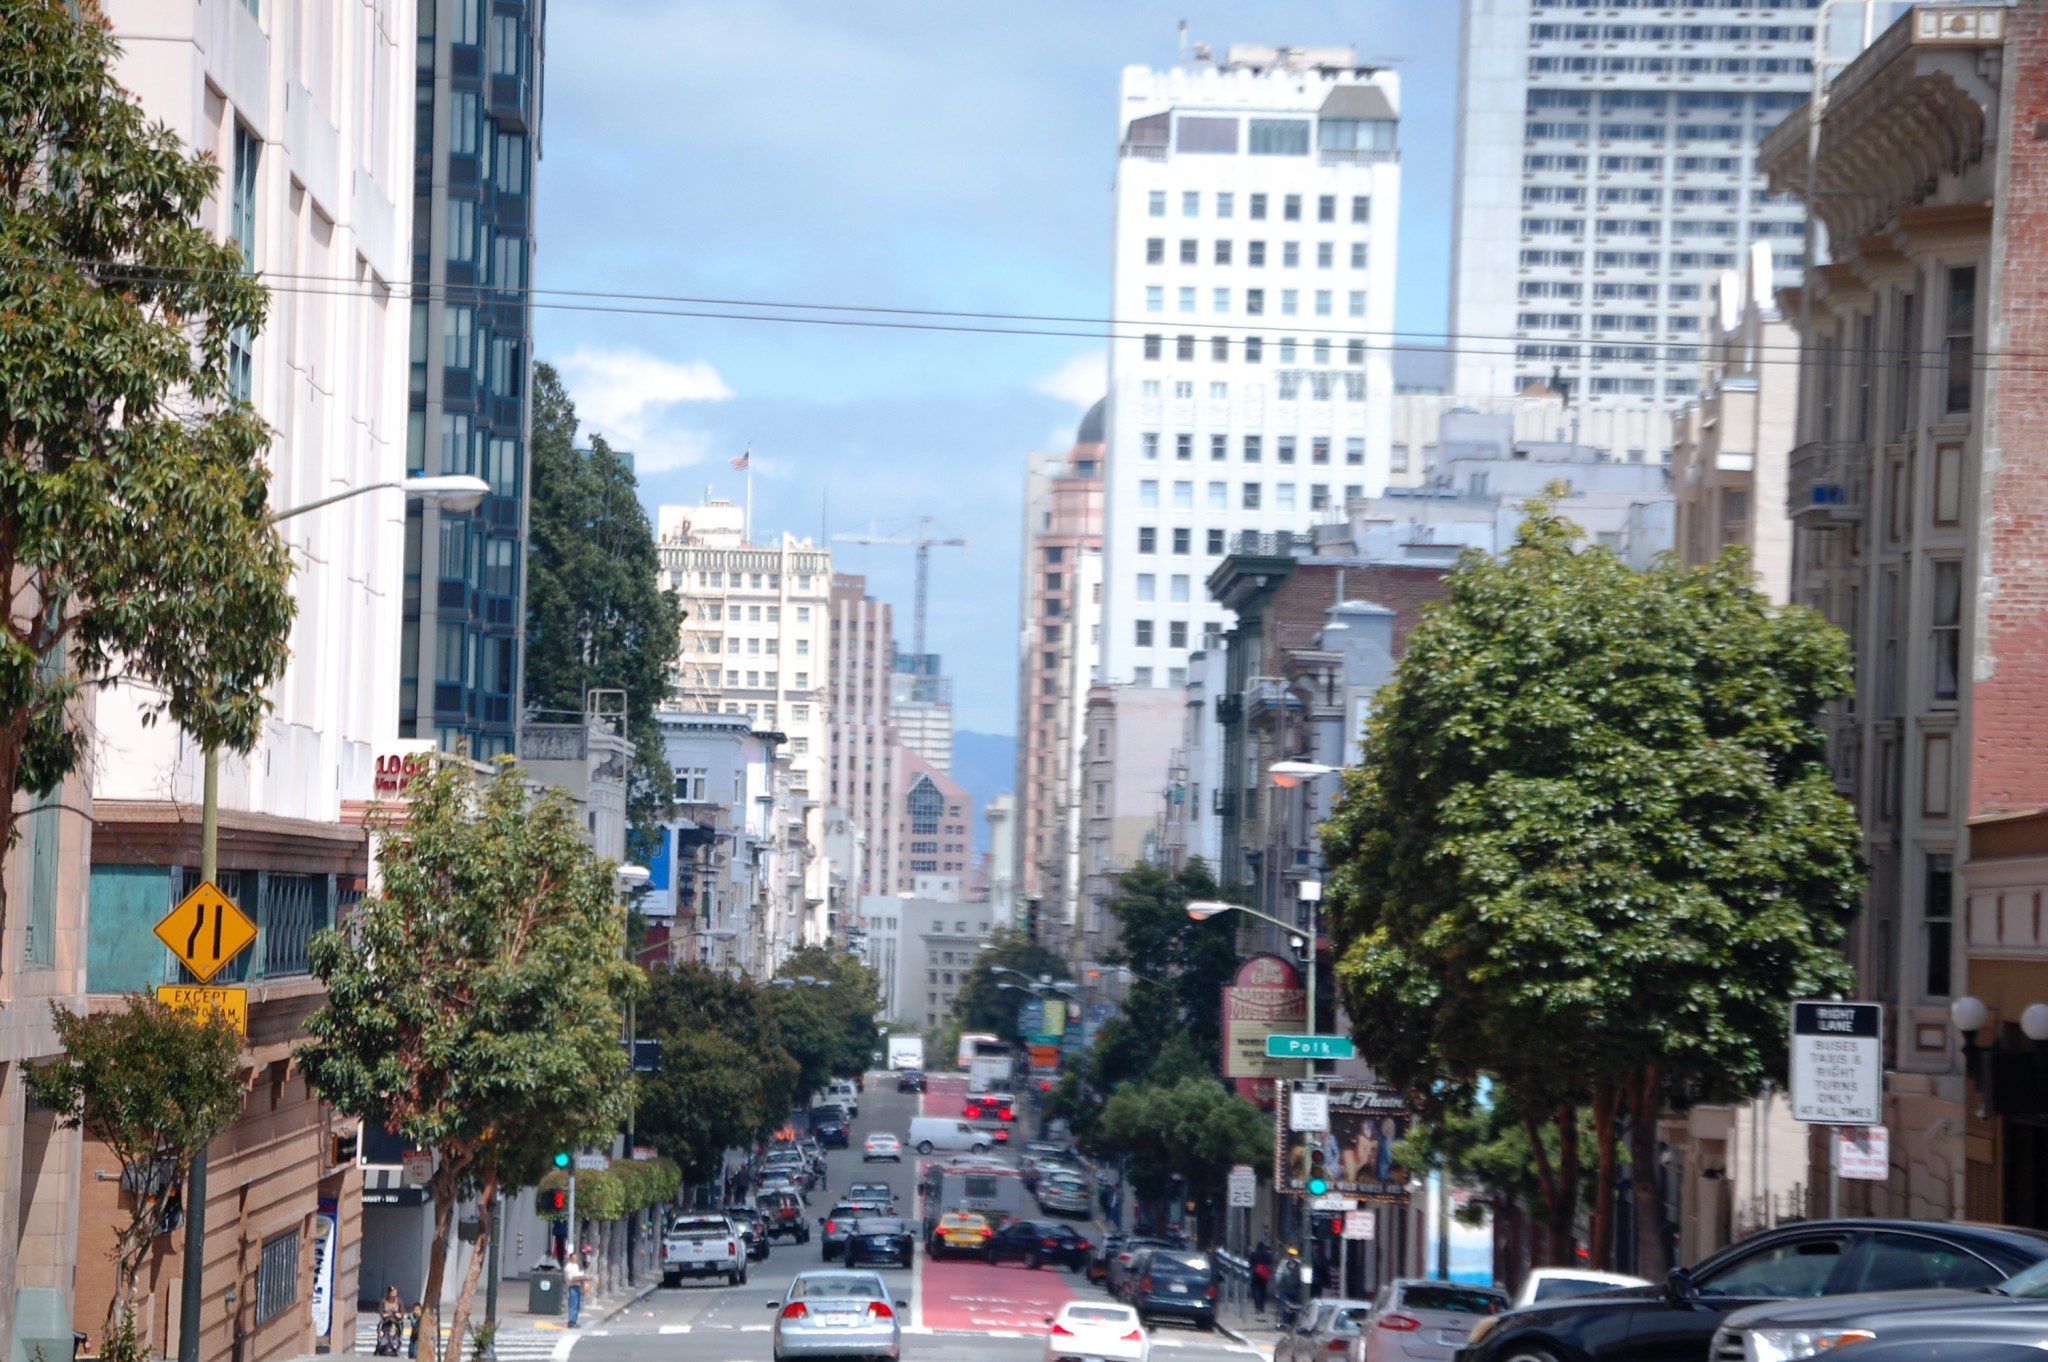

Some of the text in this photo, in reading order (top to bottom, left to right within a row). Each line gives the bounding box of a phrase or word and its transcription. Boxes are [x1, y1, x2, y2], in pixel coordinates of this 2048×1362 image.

[175, 991, 228, 1003] EXCEPT
[1816, 1008, 1856, 1021] RIGHT
[1817, 1020, 1854, 1032] LANE
[1289, 1040, 1330, 1053] Polk
[1814, 1040, 1858, 1052] BUSES
[1810, 1053, 1847, 1064] TAXIS
[1816, 1067, 1856, 1078] RIGHT
[1814, 1080, 1858, 1091] TURNS
[1817, 1093, 1854, 1104] ONLY
[1800, 1105, 1814, 1114] AT
[1840, 1107, 1872, 1117] TIMES
[1232, 1191, 1253, 1203] 25
